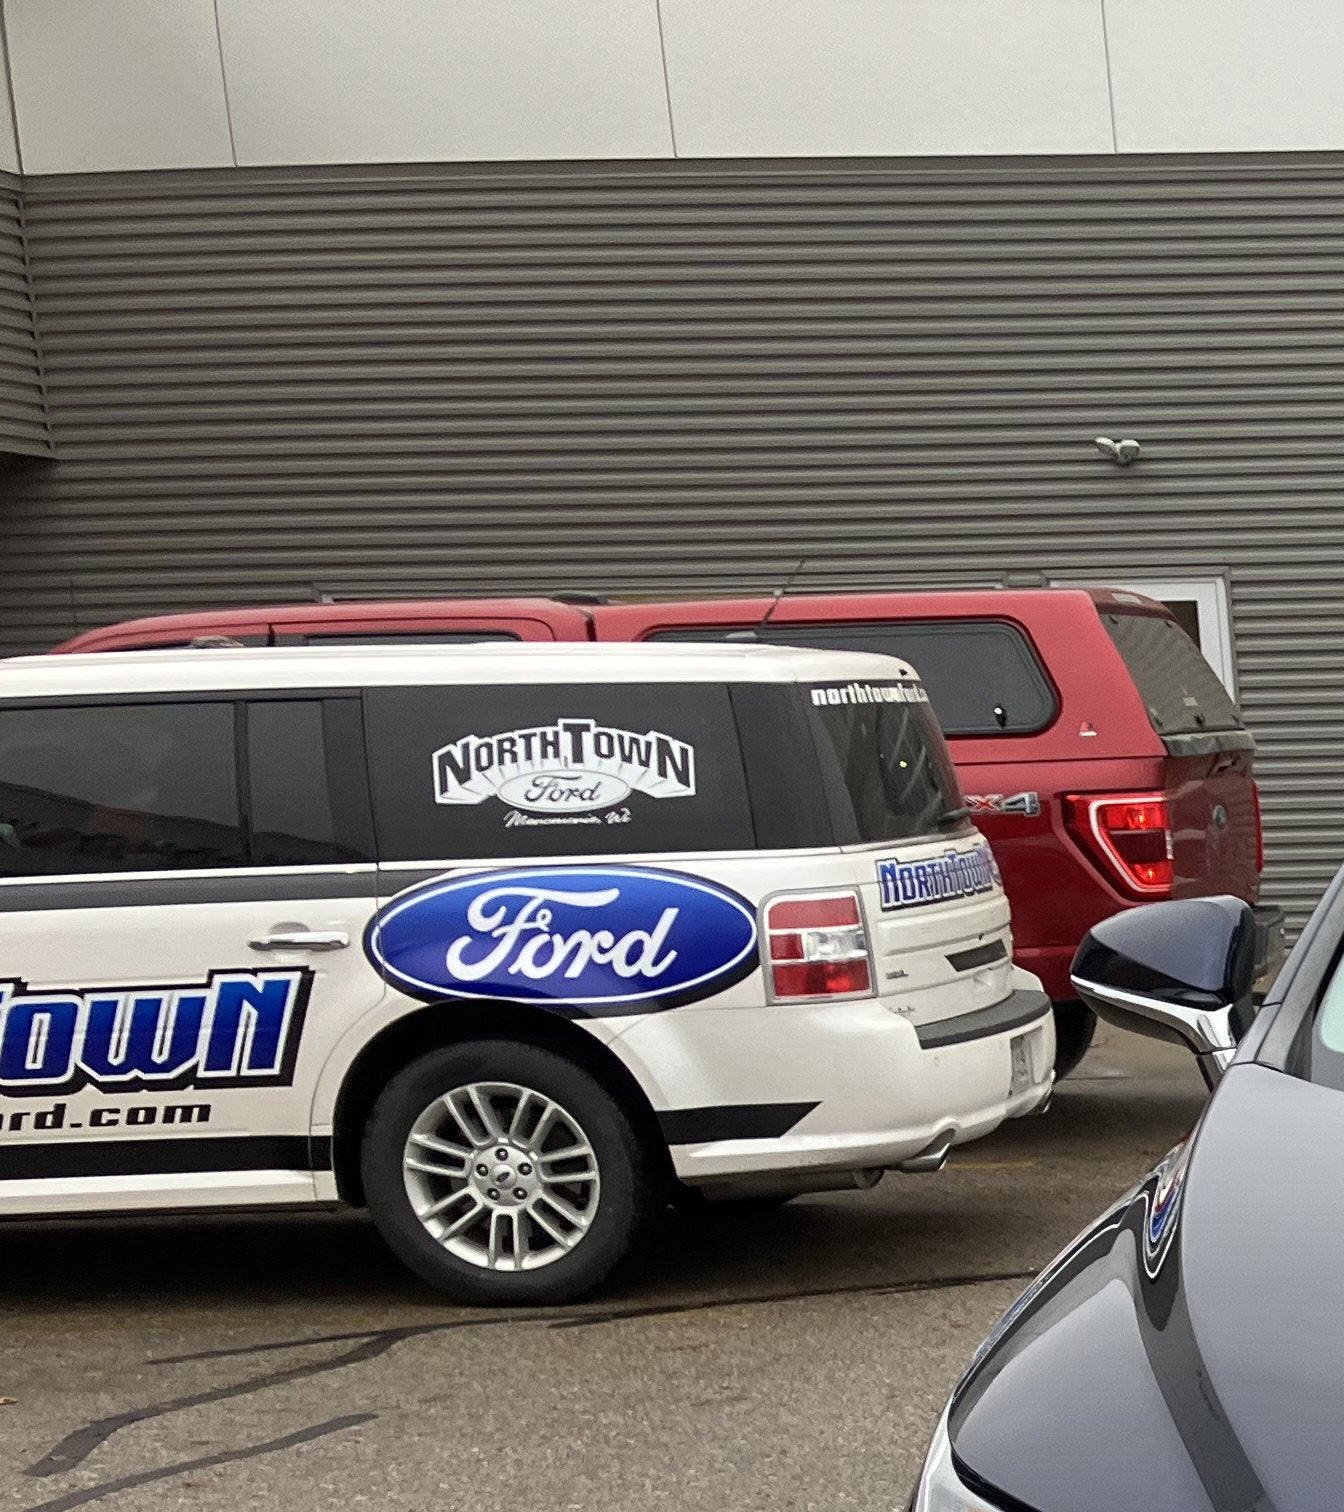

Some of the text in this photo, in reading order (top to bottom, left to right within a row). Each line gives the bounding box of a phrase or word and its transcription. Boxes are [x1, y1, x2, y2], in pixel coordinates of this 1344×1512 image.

[523, 774, 602, 802] Ford
[445, 886, 680, 982] Ford
[0, 970, 306, 1088] OWN
[0, 1103, 212, 1132] rd.com
